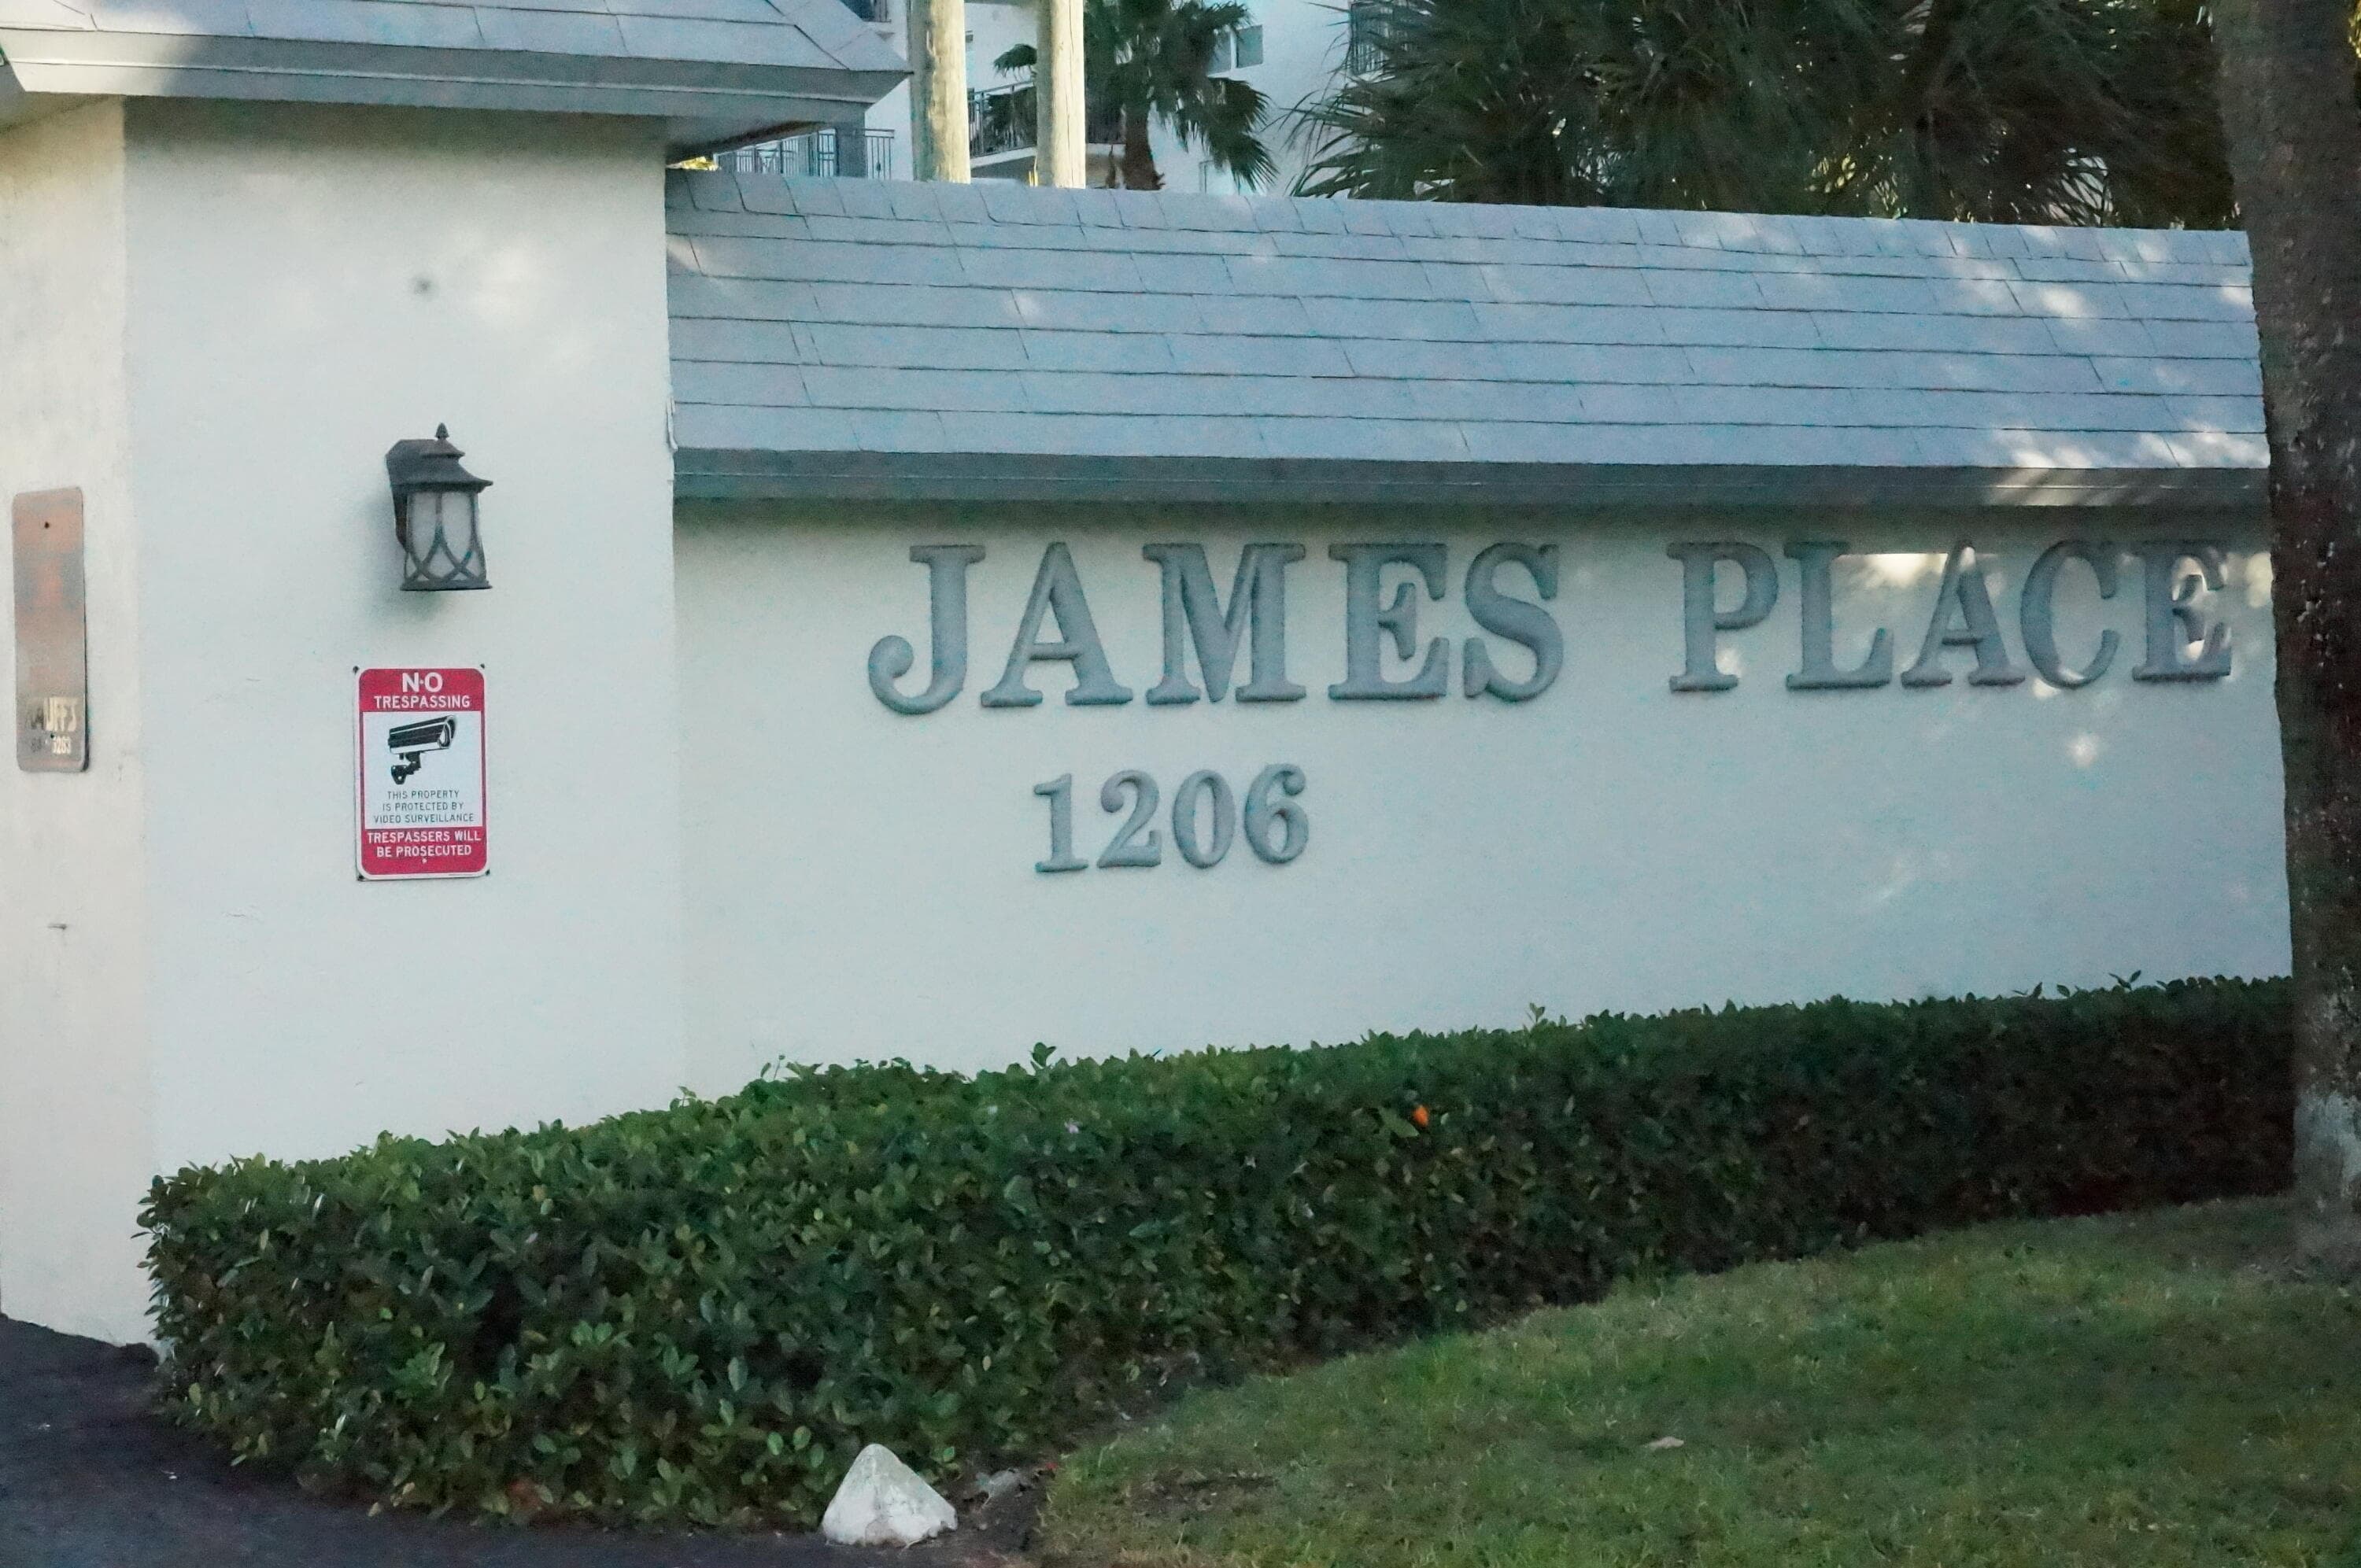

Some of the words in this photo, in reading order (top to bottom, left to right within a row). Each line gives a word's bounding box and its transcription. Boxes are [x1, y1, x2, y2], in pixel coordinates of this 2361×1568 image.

[867, 540, 1565, 717] JAMES
[1665, 539, 2234, 692] PLACE
[402, 672, 443, 692] NO
[374, 695, 471, 709] TRESPASSING
[387, 790, 408, 800] THIS
[411, 789, 460, 799] PROPERTY
[382, 802, 391, 812] IS
[395, 802, 449, 811] PROTECTED
[452, 802, 464, 810] BY
[373, 814, 401, 824] VIDEO
[405, 813, 475, 823] SURVEILLANCE
[1033, 762, 1310, 873] 1206
[367, 831, 451, 843] TRESPASSERS
[454, 830, 482, 841] WILL
[376, 846, 393, 858] BE
[396, 844, 472, 858] PROSECUTED
